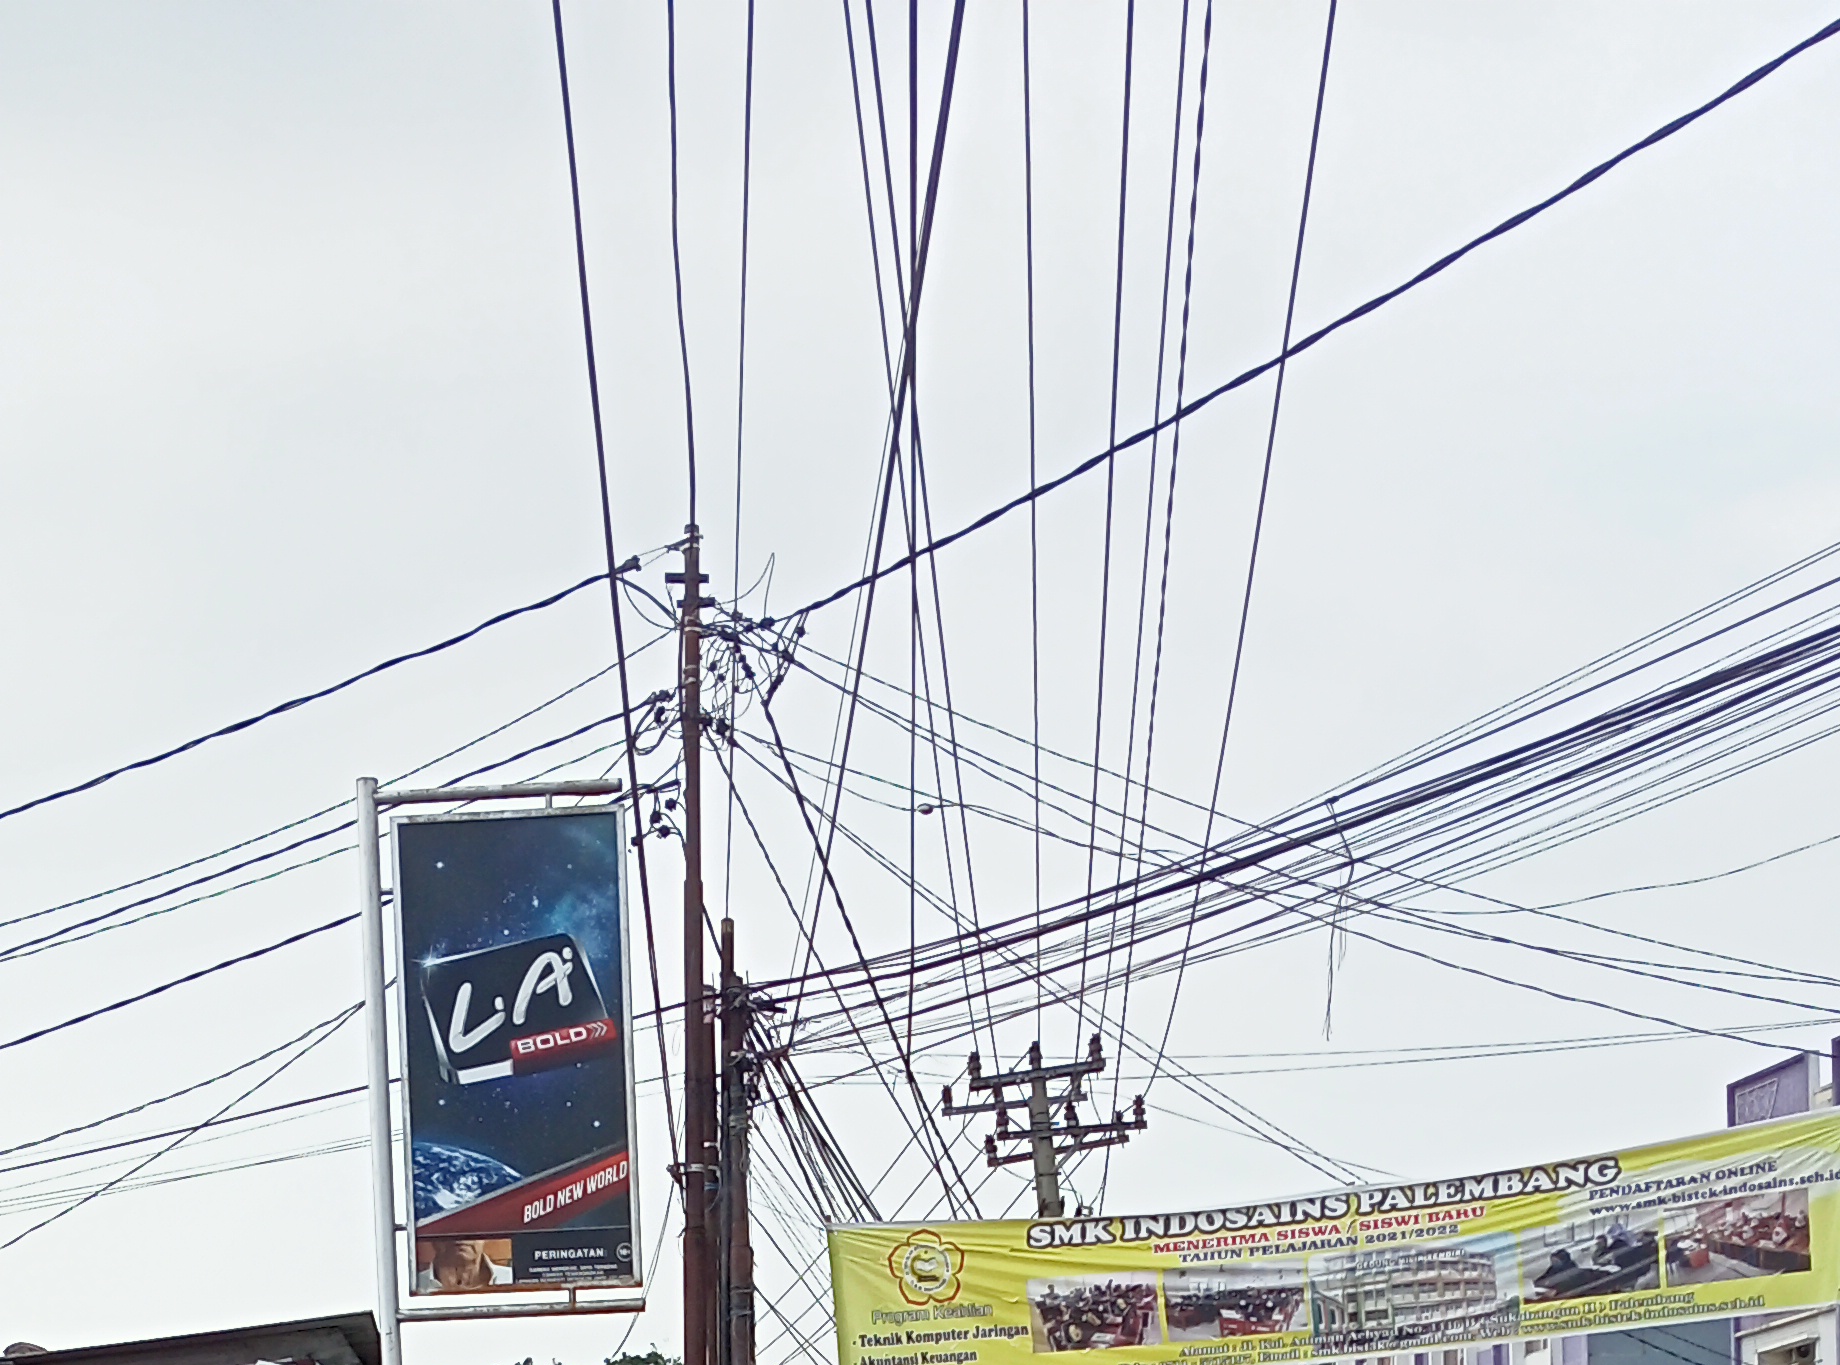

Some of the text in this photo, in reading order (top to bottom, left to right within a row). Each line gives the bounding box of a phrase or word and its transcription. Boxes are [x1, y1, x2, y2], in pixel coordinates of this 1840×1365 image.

[516, 1026, 588, 1055] BOLD
[523, 1160, 628, 1224] BOLD NEW WORLD
[1588, 1160, 1778, 1200] PENDAFTARAN ONLINE
[1028, 1158, 1620, 1248] SMK INDOSAINS PALEMBANG
[1153, 1232, 1269, 1254] MENERIMA
[1276, 1224, 1340, 1241] SISWA
[1358, 1213, 1420, 1233] SISWI
[1427, 1206, 1485, 1224] BARU
[1178, 1223, 1460, 1263] TAHUN PELAJARAN 2021/2022
[534, 1247, 604, 1260] PERINGATAN
[858, 1324, 1029, 1348] Teknik Komputer Jaringan
[920, 1350, 978, 1365] Keuangan
